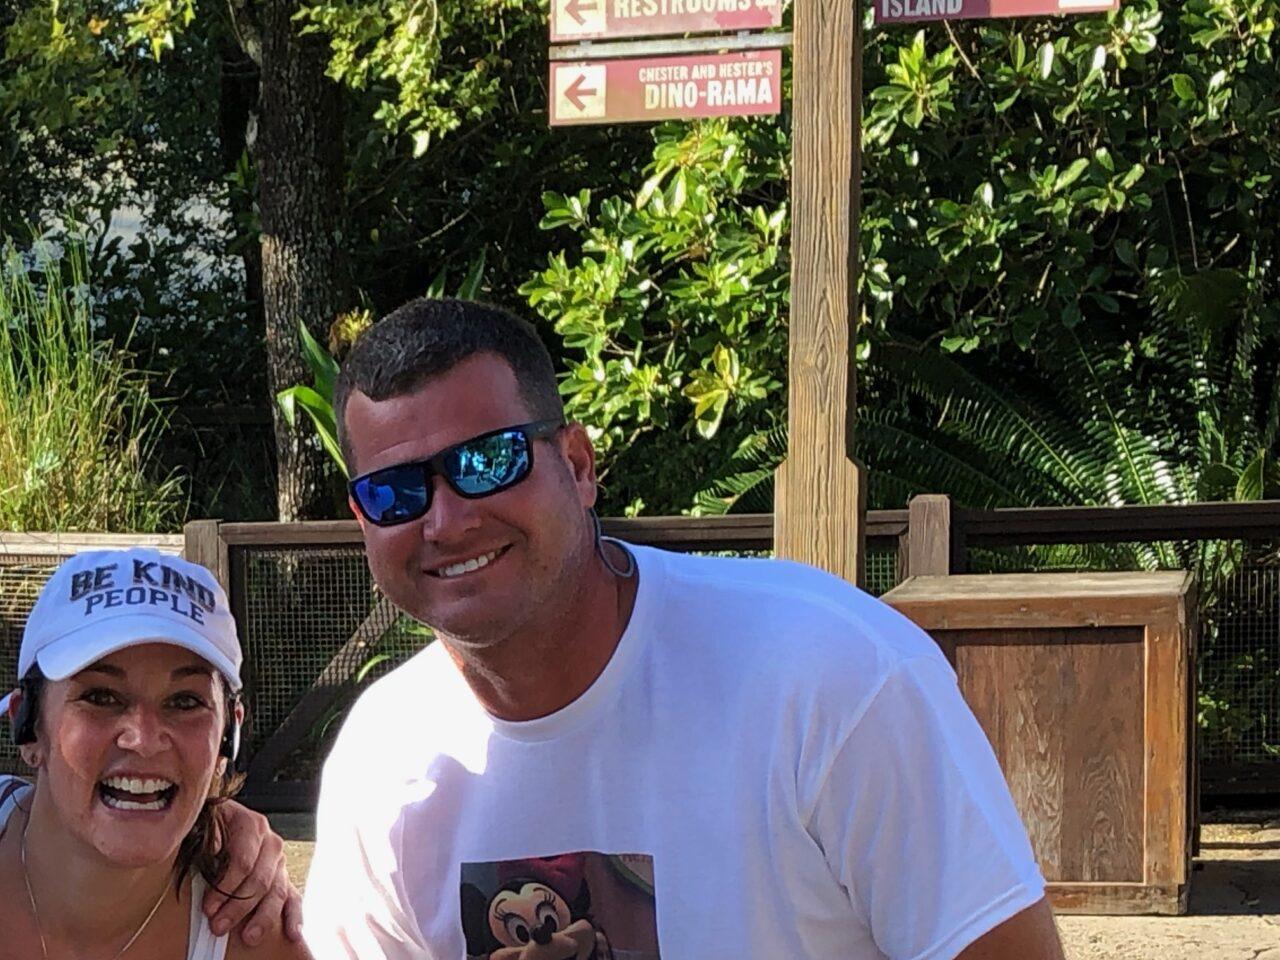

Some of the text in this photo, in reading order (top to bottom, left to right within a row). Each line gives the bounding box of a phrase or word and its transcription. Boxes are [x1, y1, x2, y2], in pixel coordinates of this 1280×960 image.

[882, 0, 963, 17] ISLAND
[638, 61, 773, 83] CHESTER AND HESTER'S
[644, 78, 773, 110] DINO-RAMA
[71, 558, 216, 613] BE KIND
[85, 586, 205, 626] PEOPLE
